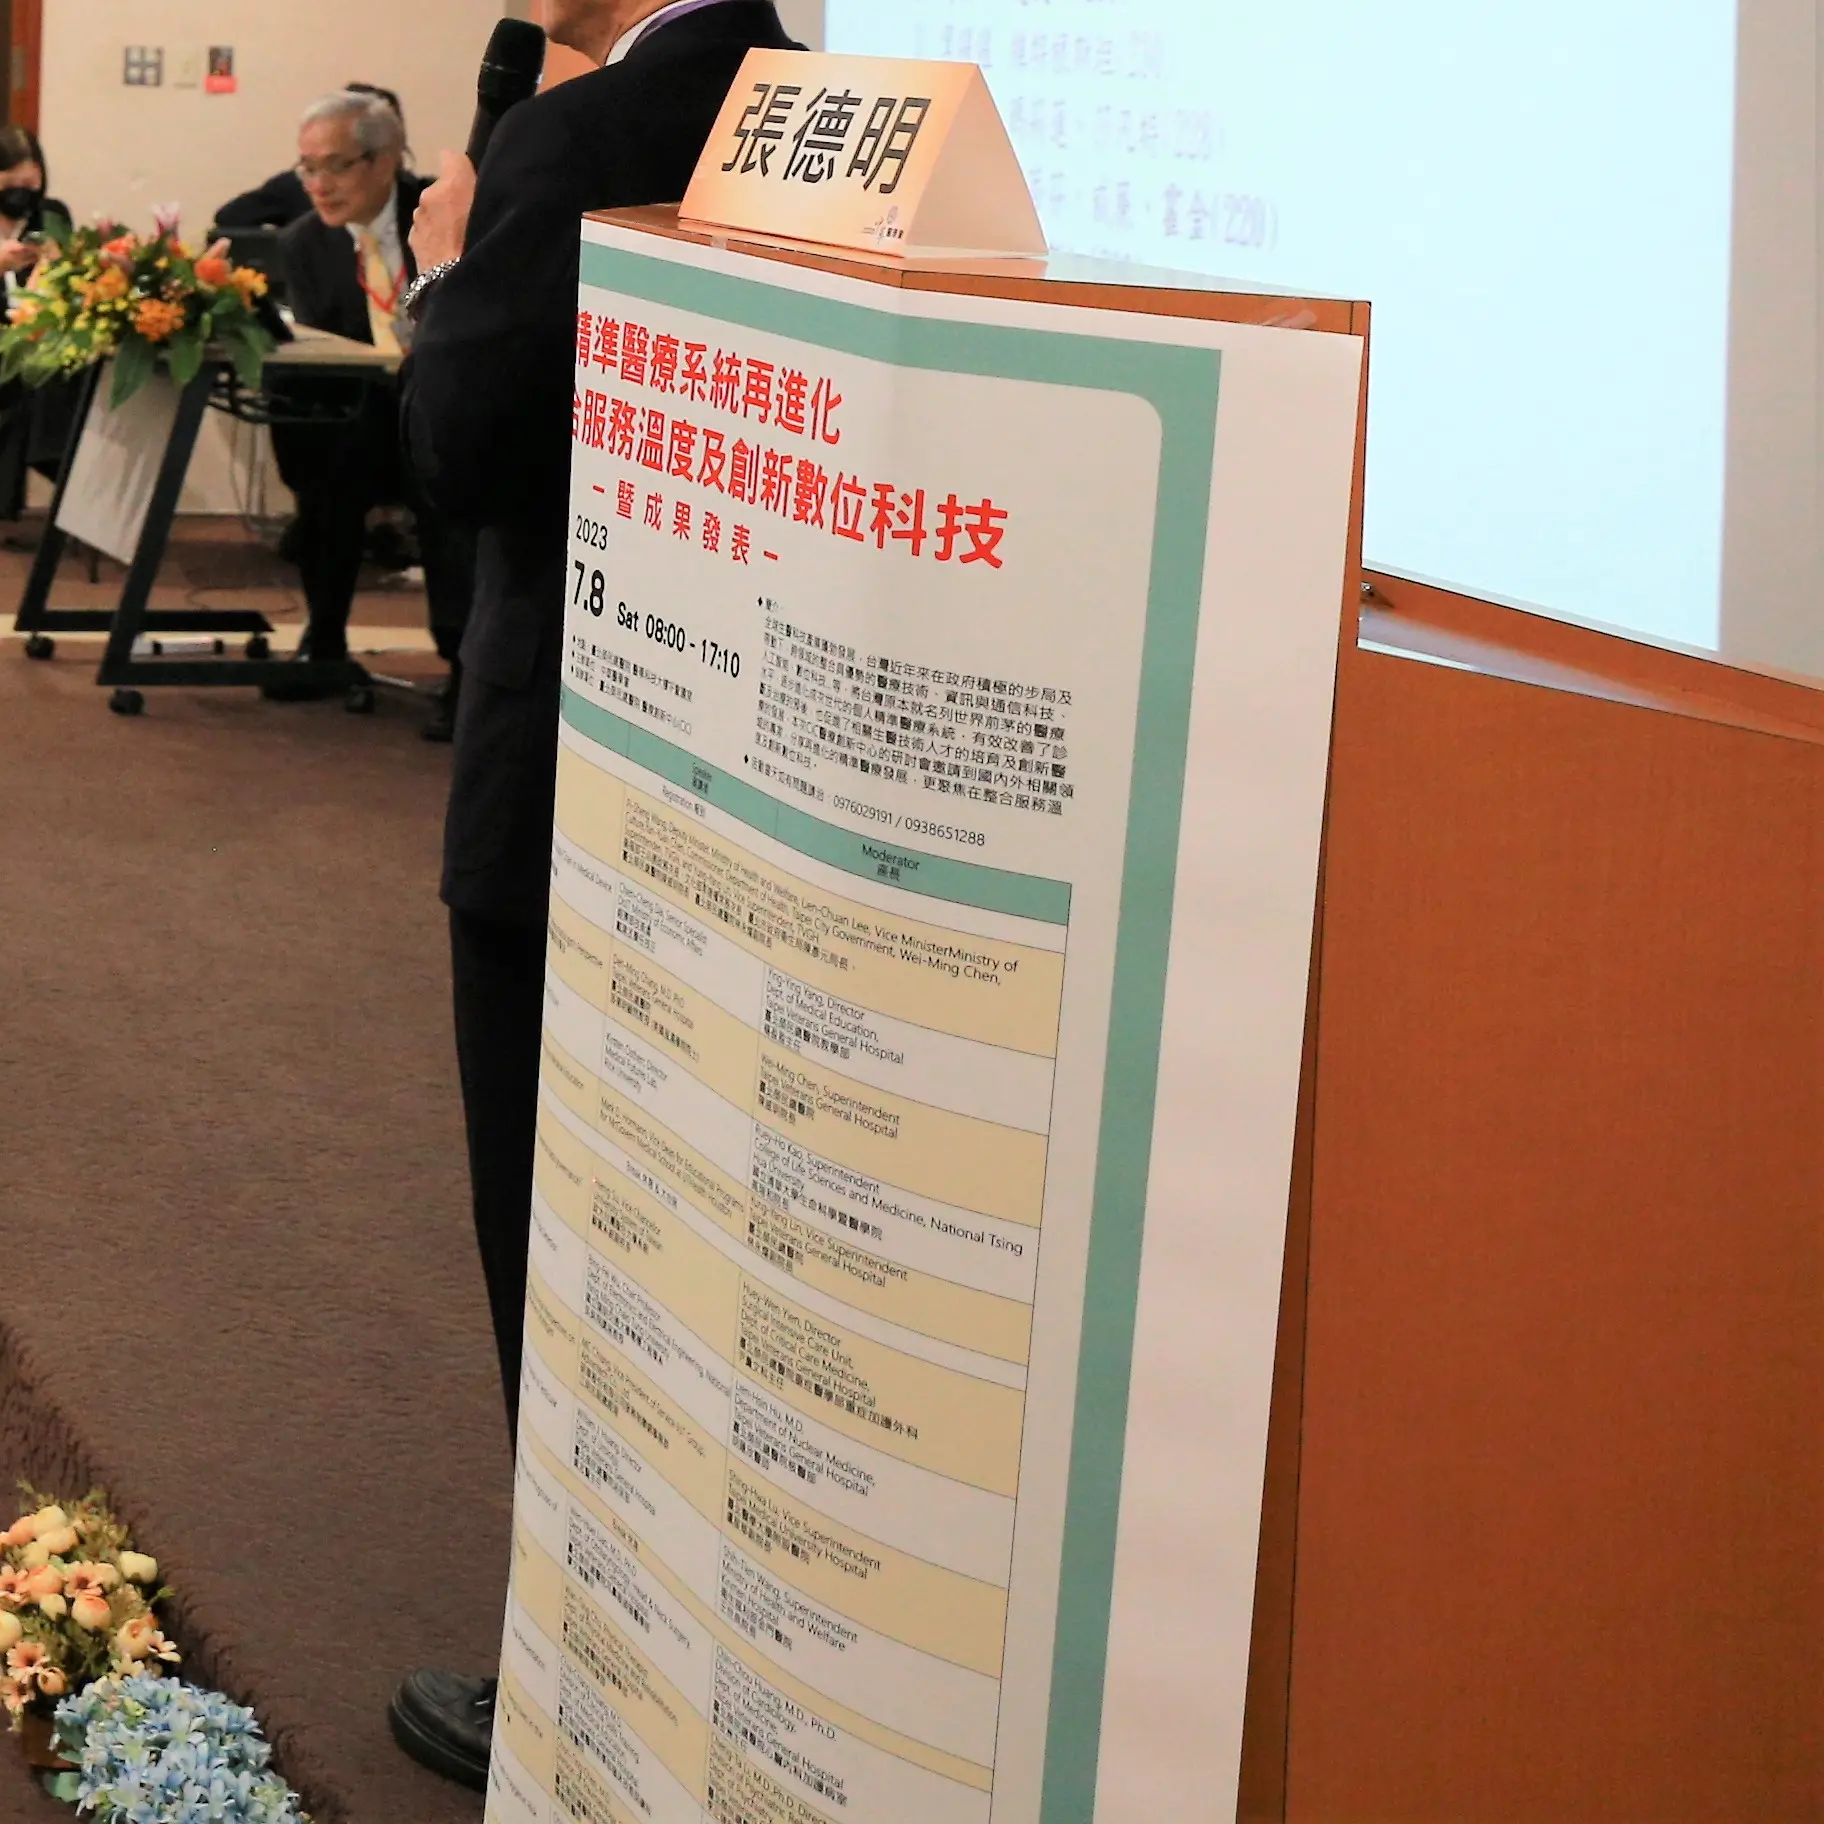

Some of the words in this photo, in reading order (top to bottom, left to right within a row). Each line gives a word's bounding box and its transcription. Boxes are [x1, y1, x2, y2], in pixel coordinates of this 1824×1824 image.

[721, 82, 932, 194] 張德明
[575, 514, 608, 551] 2023
[572, 559, 606, 617] 7.8
[617, 601, 640, 633] Sat
[645, 613, 686, 653] 08:00
[701, 638, 741, 679] 17:10
[832, 794, 893, 826] 0976029191
[904, 817, 986, 847] 0938651288
[861, 843, 921, 871] Moderator
[874, 926, 899, 943] Vice
[1003, 959, 1020, 973] of
[900, 947, 960, 978] Wei-Ming
[963, 964, 1002, 987] Chen,
[827, 996, 866, 1021] Director
[828, 1011, 880, 1043] Education,
[820, 1023, 858, 1049] General
[859, 1039, 905, 1066] Hospital
[814, 1097, 852, 1123] General
[854, 1113, 899, 1140] Hospital
[823, 1084, 901, 1126] Superintendent
[806, 1152, 881, 1195] Superintendent
[807, 1167, 847, 1196] Sciences
[848, 1186, 869, 1206] and
[872, 1195, 928, 1229] Medicine,
[930, 1216, 985, 1245] National
[988, 1234, 1024, 1257] Tsing
[804, 1242, 842, 1269] General
[842, 1258, 887, 1288] Hospital
[827, 1237, 909, 1283] Superintendent
[804, 1319, 842, 1348] Director
[807, 1334, 830, 1358] Care
[798, 1345, 821, 1367] Care
[822, 1358, 870, 1393] Medicine,
[833, 1376, 877, 1408] Hospital
[825, 1451, 877, 1487] Medicine,
[825, 1466, 870, 1498] Hospital
[802, 1520, 882, 1572] Superintendent
[824, 1547, 869, 1581] Hospital
[784, 1590, 859, 1644] Superintendent
[807, 1620, 847, 1653] Welfare
[801, 1756, 845, 1790] Hospital
